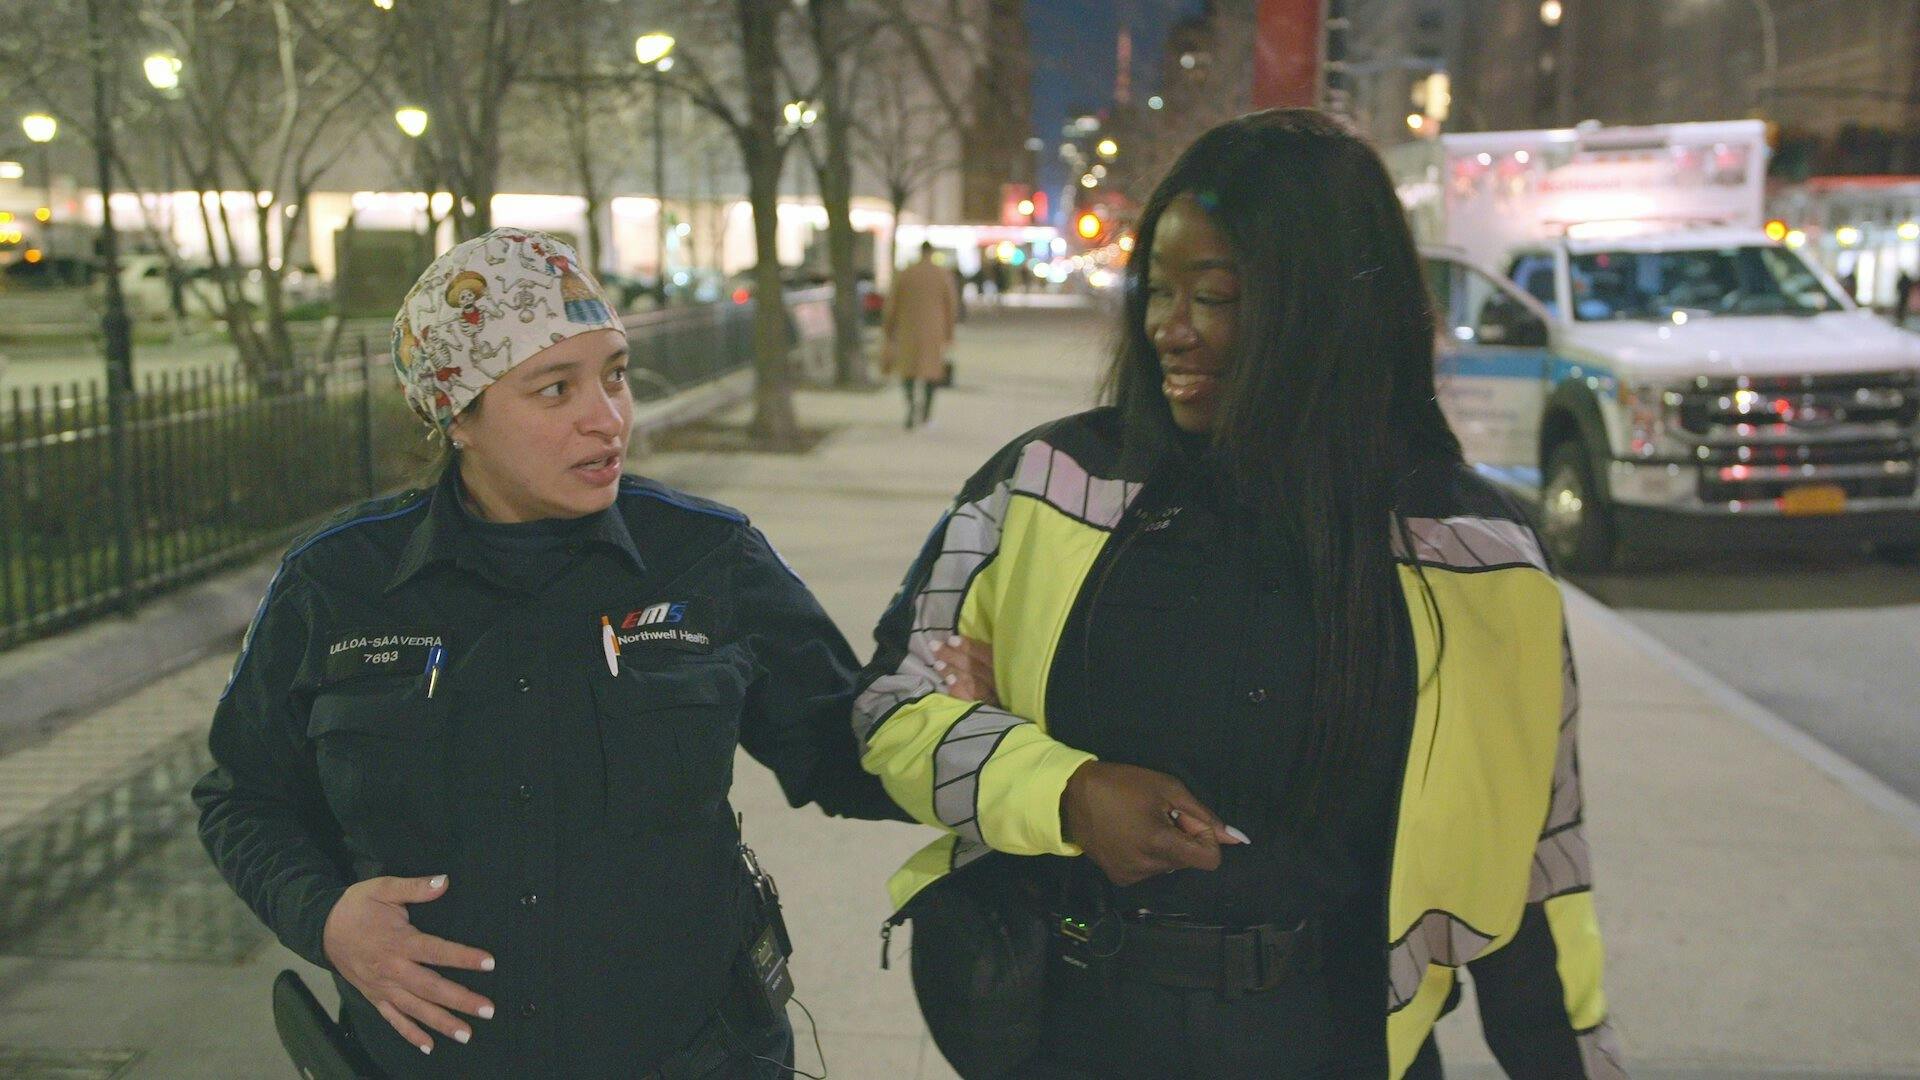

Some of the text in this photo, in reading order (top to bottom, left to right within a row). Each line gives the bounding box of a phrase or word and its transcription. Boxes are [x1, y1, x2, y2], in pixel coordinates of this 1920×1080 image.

[329, 635, 442, 655] ULLOA-SAAVEDRA
[617, 629, 710, 645] Northwell Health
[363, 650, 399, 664] 7693
